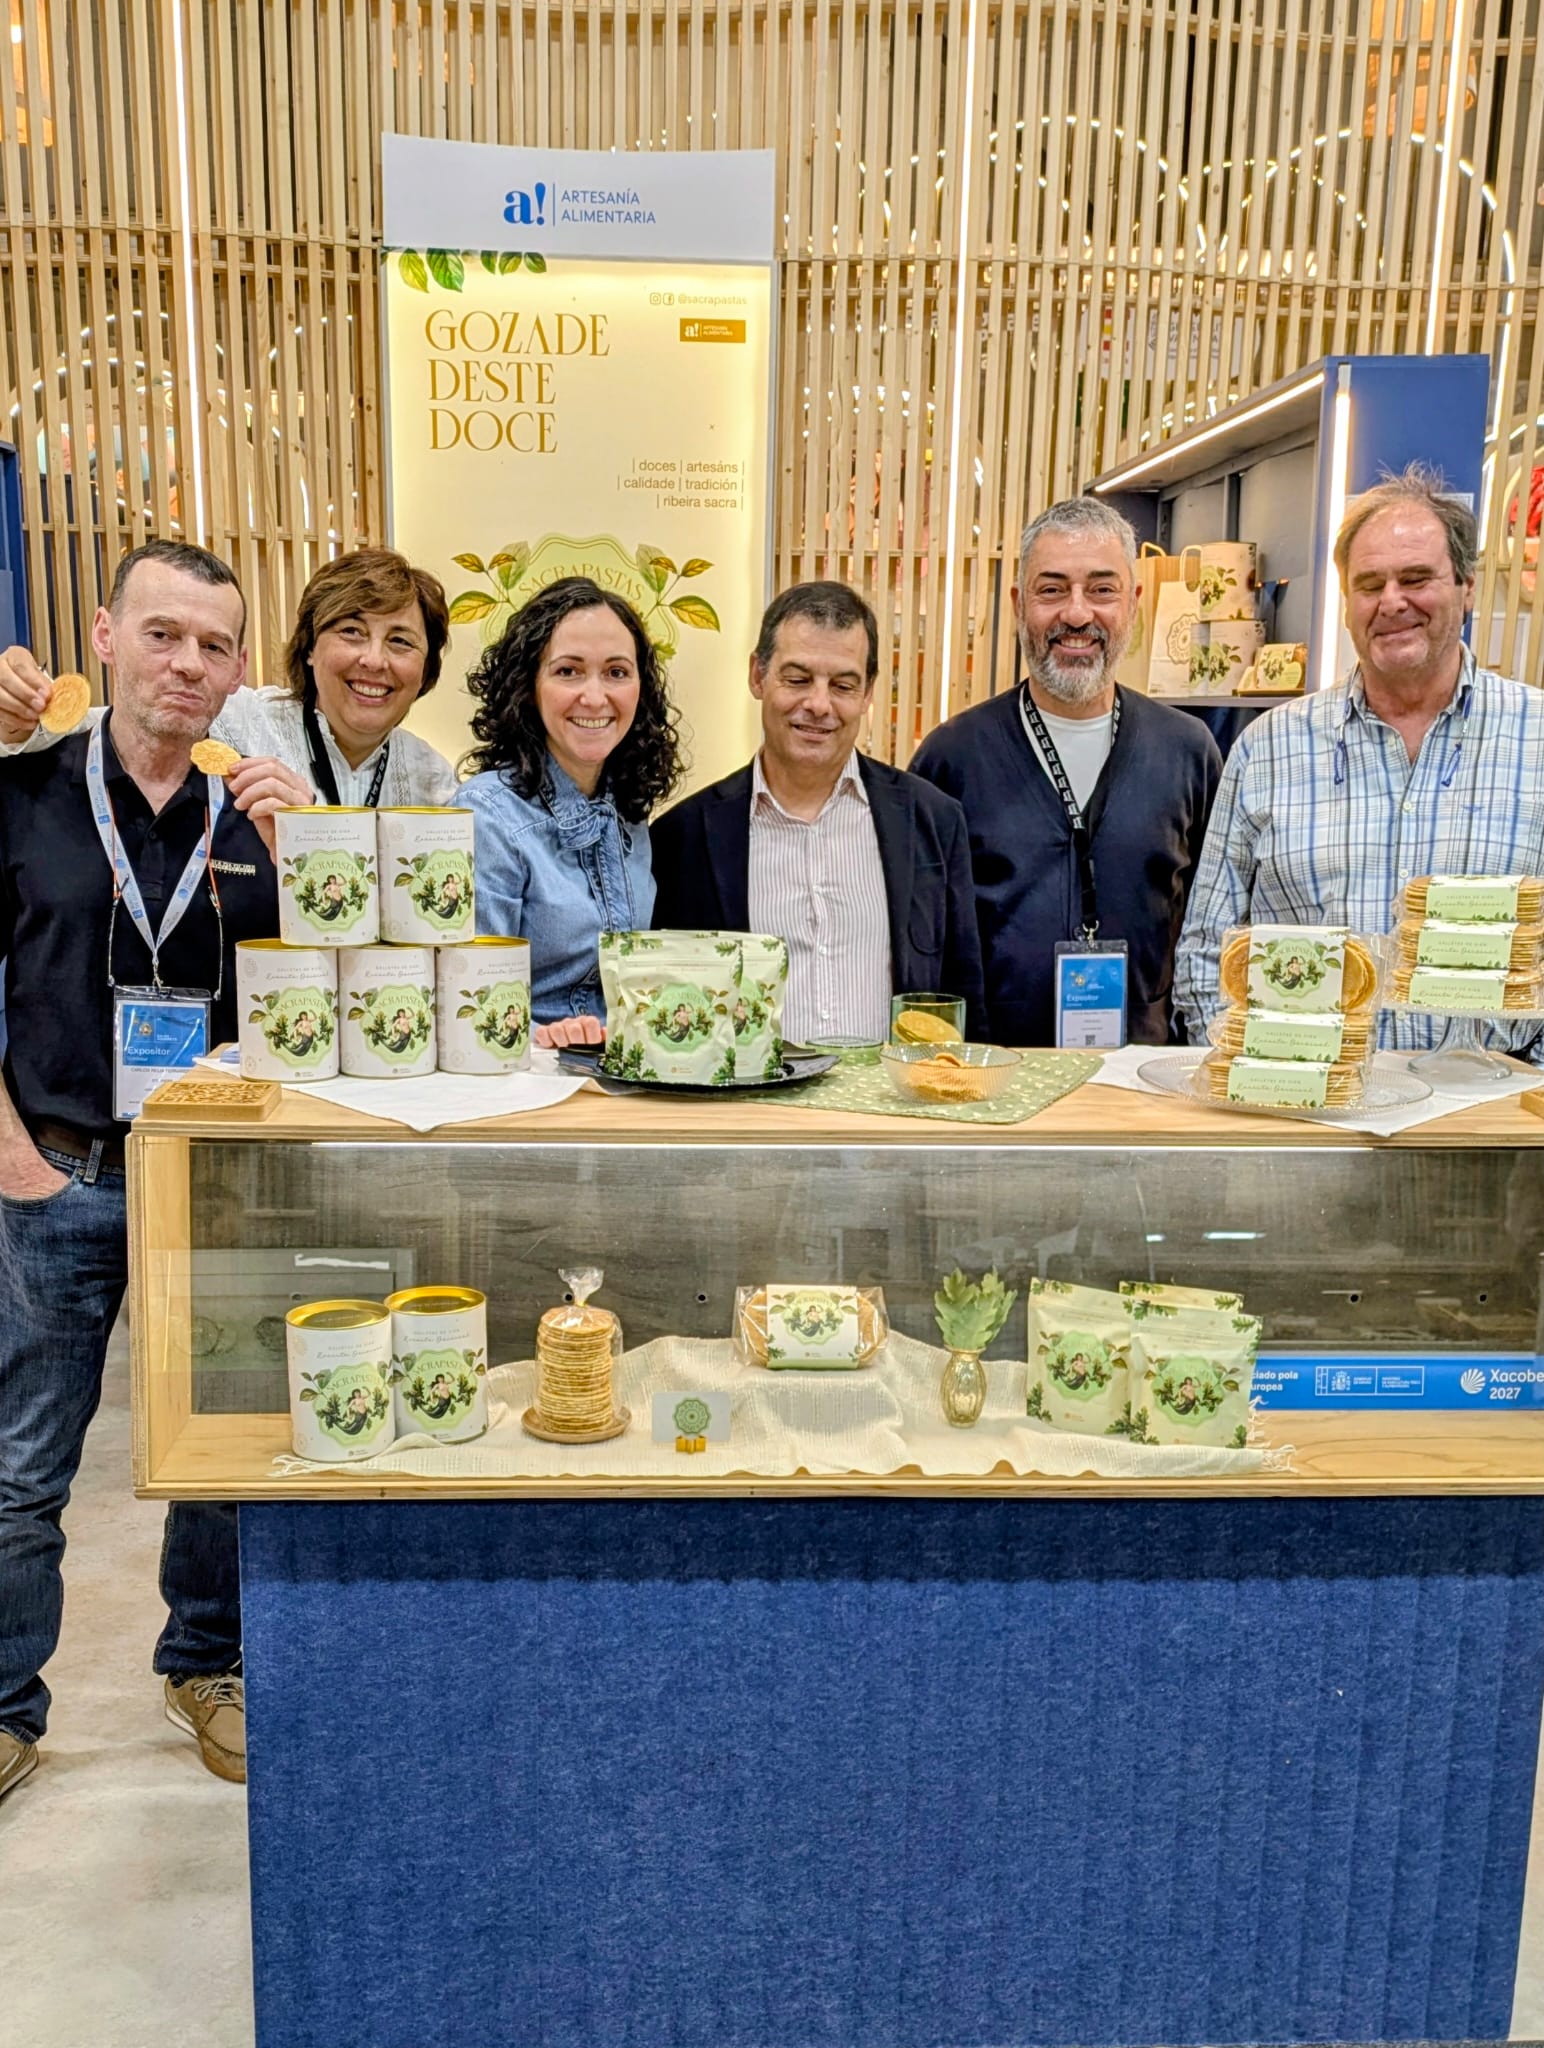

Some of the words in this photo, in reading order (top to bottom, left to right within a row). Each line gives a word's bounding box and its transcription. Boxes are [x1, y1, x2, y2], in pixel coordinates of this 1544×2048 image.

[561, 188, 640, 205] ARTESANÍA
[503, 182, 546, 226] a!
[561, 210, 656, 224] ALIMENTARIA
[678, 293, 747, 307] @sacrapastas
[425, 309, 611, 356] GOZADE
[428, 359, 557, 404] DESTE
[428, 408, 558, 454] DOCE
[639, 459, 676, 472] doces
[686, 460, 738, 473] artesáns
[624, 477, 675, 489] calidade
[685, 478, 737, 490] tradición
[663, 496, 701, 507] ribeira
[704, 498, 737, 508] sacra
[519, 563, 644, 601] SACRAPASTAS
[128, 1046, 171, 1056] Expositor
[1252, 1370, 1276, 1379] ciado
[1278, 1370, 1299, 1381] pola
[1490, 1369, 1544, 1383] Xacobe
[1251, 1383, 1283, 1392] uropea
[1489, 1387, 1522, 1400] 2027
